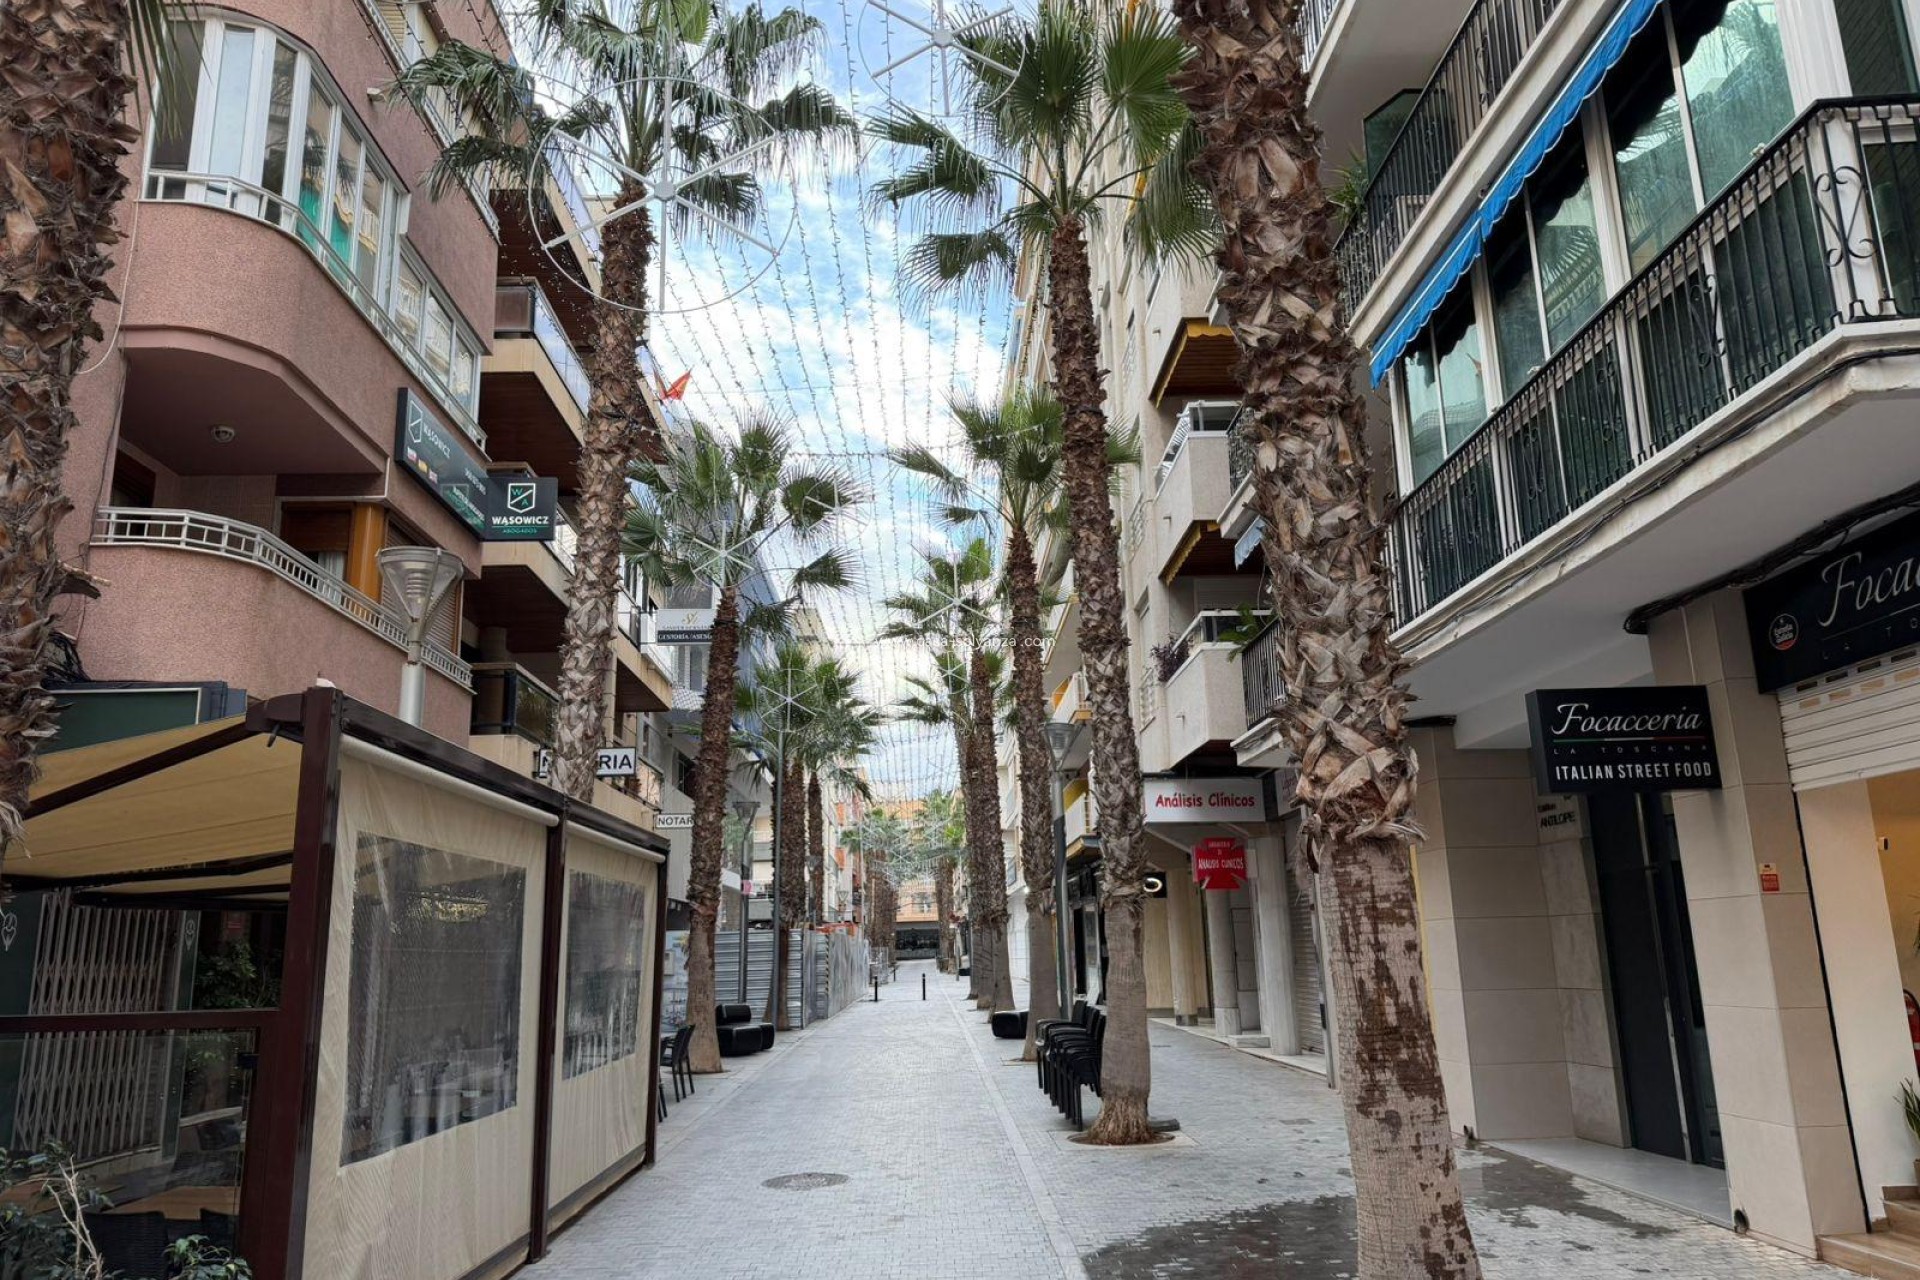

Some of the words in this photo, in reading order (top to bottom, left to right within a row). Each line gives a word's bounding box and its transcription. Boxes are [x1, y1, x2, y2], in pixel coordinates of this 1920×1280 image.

[1817, 551, 1920, 628] Foca
[1551, 703, 1703, 735] Focacceria
[1555, 765, 1614, 780] ITALIAN
[1617, 763, 1670, 779] STREET
[1674, 761, 1712, 777] FOOD
[1155, 792, 1203, 807] Análisis
[1208, 792, 1255, 807] Clínicos
